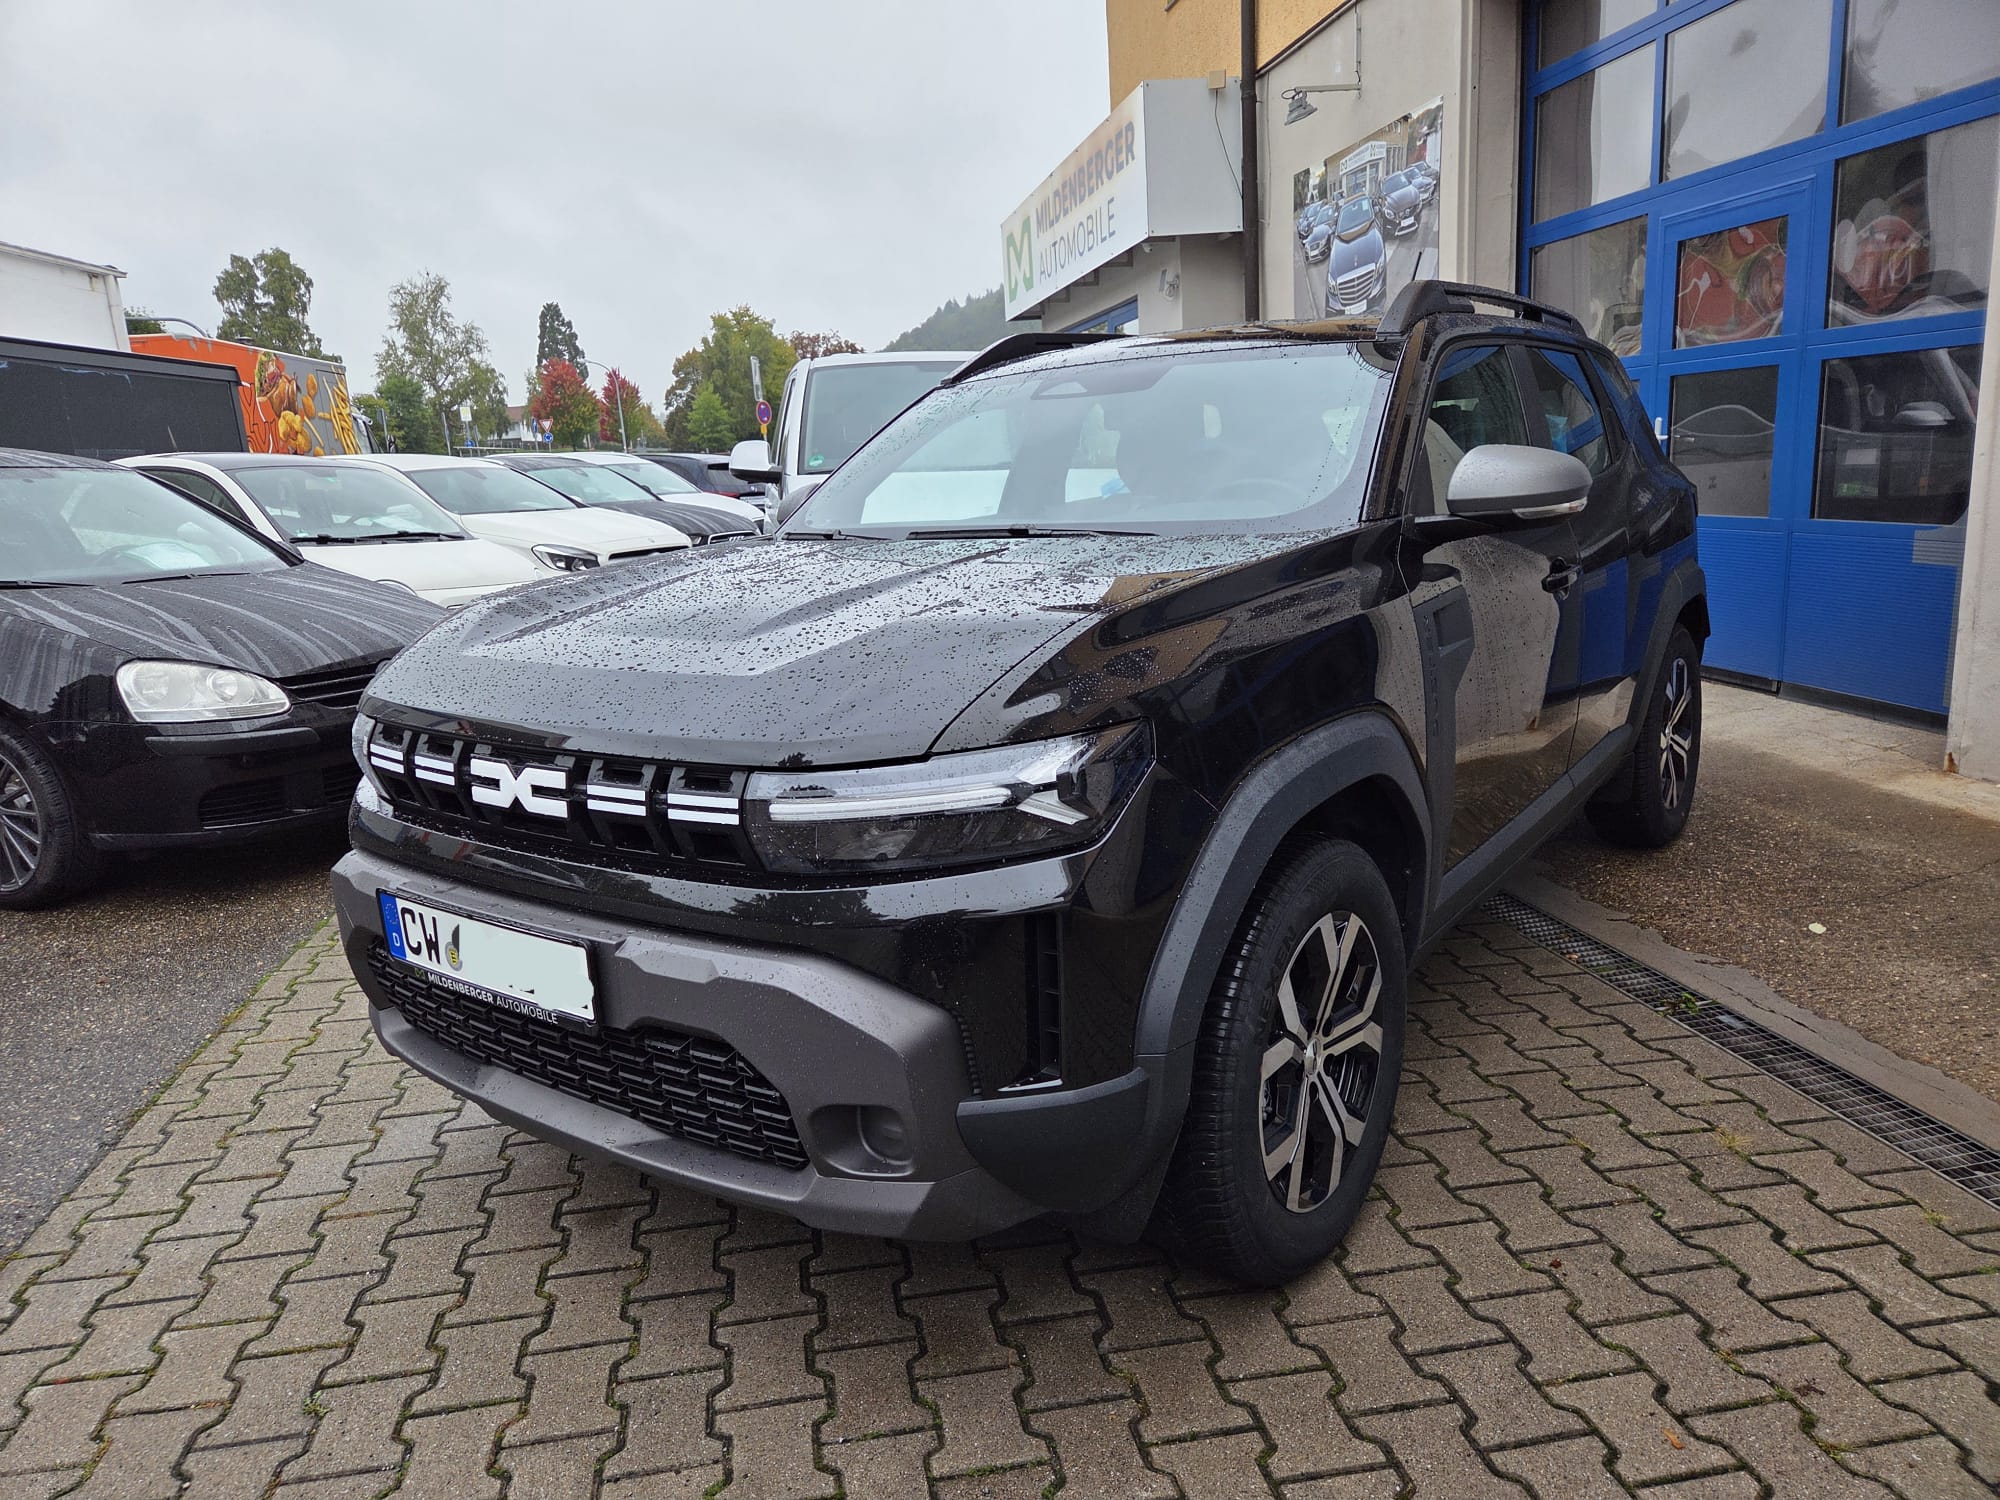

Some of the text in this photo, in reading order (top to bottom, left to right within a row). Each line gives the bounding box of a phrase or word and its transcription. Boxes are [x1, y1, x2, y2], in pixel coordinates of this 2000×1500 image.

[1036, 121, 1135, 239] MILDENBERGER
[1039, 197, 1116, 284] AUTOMOBILE
[393, 907, 441, 964] D CW
[427, 972, 494, 1004] MILDENBERGER
[496, 996, 558, 1025] AUTOMOBILE
